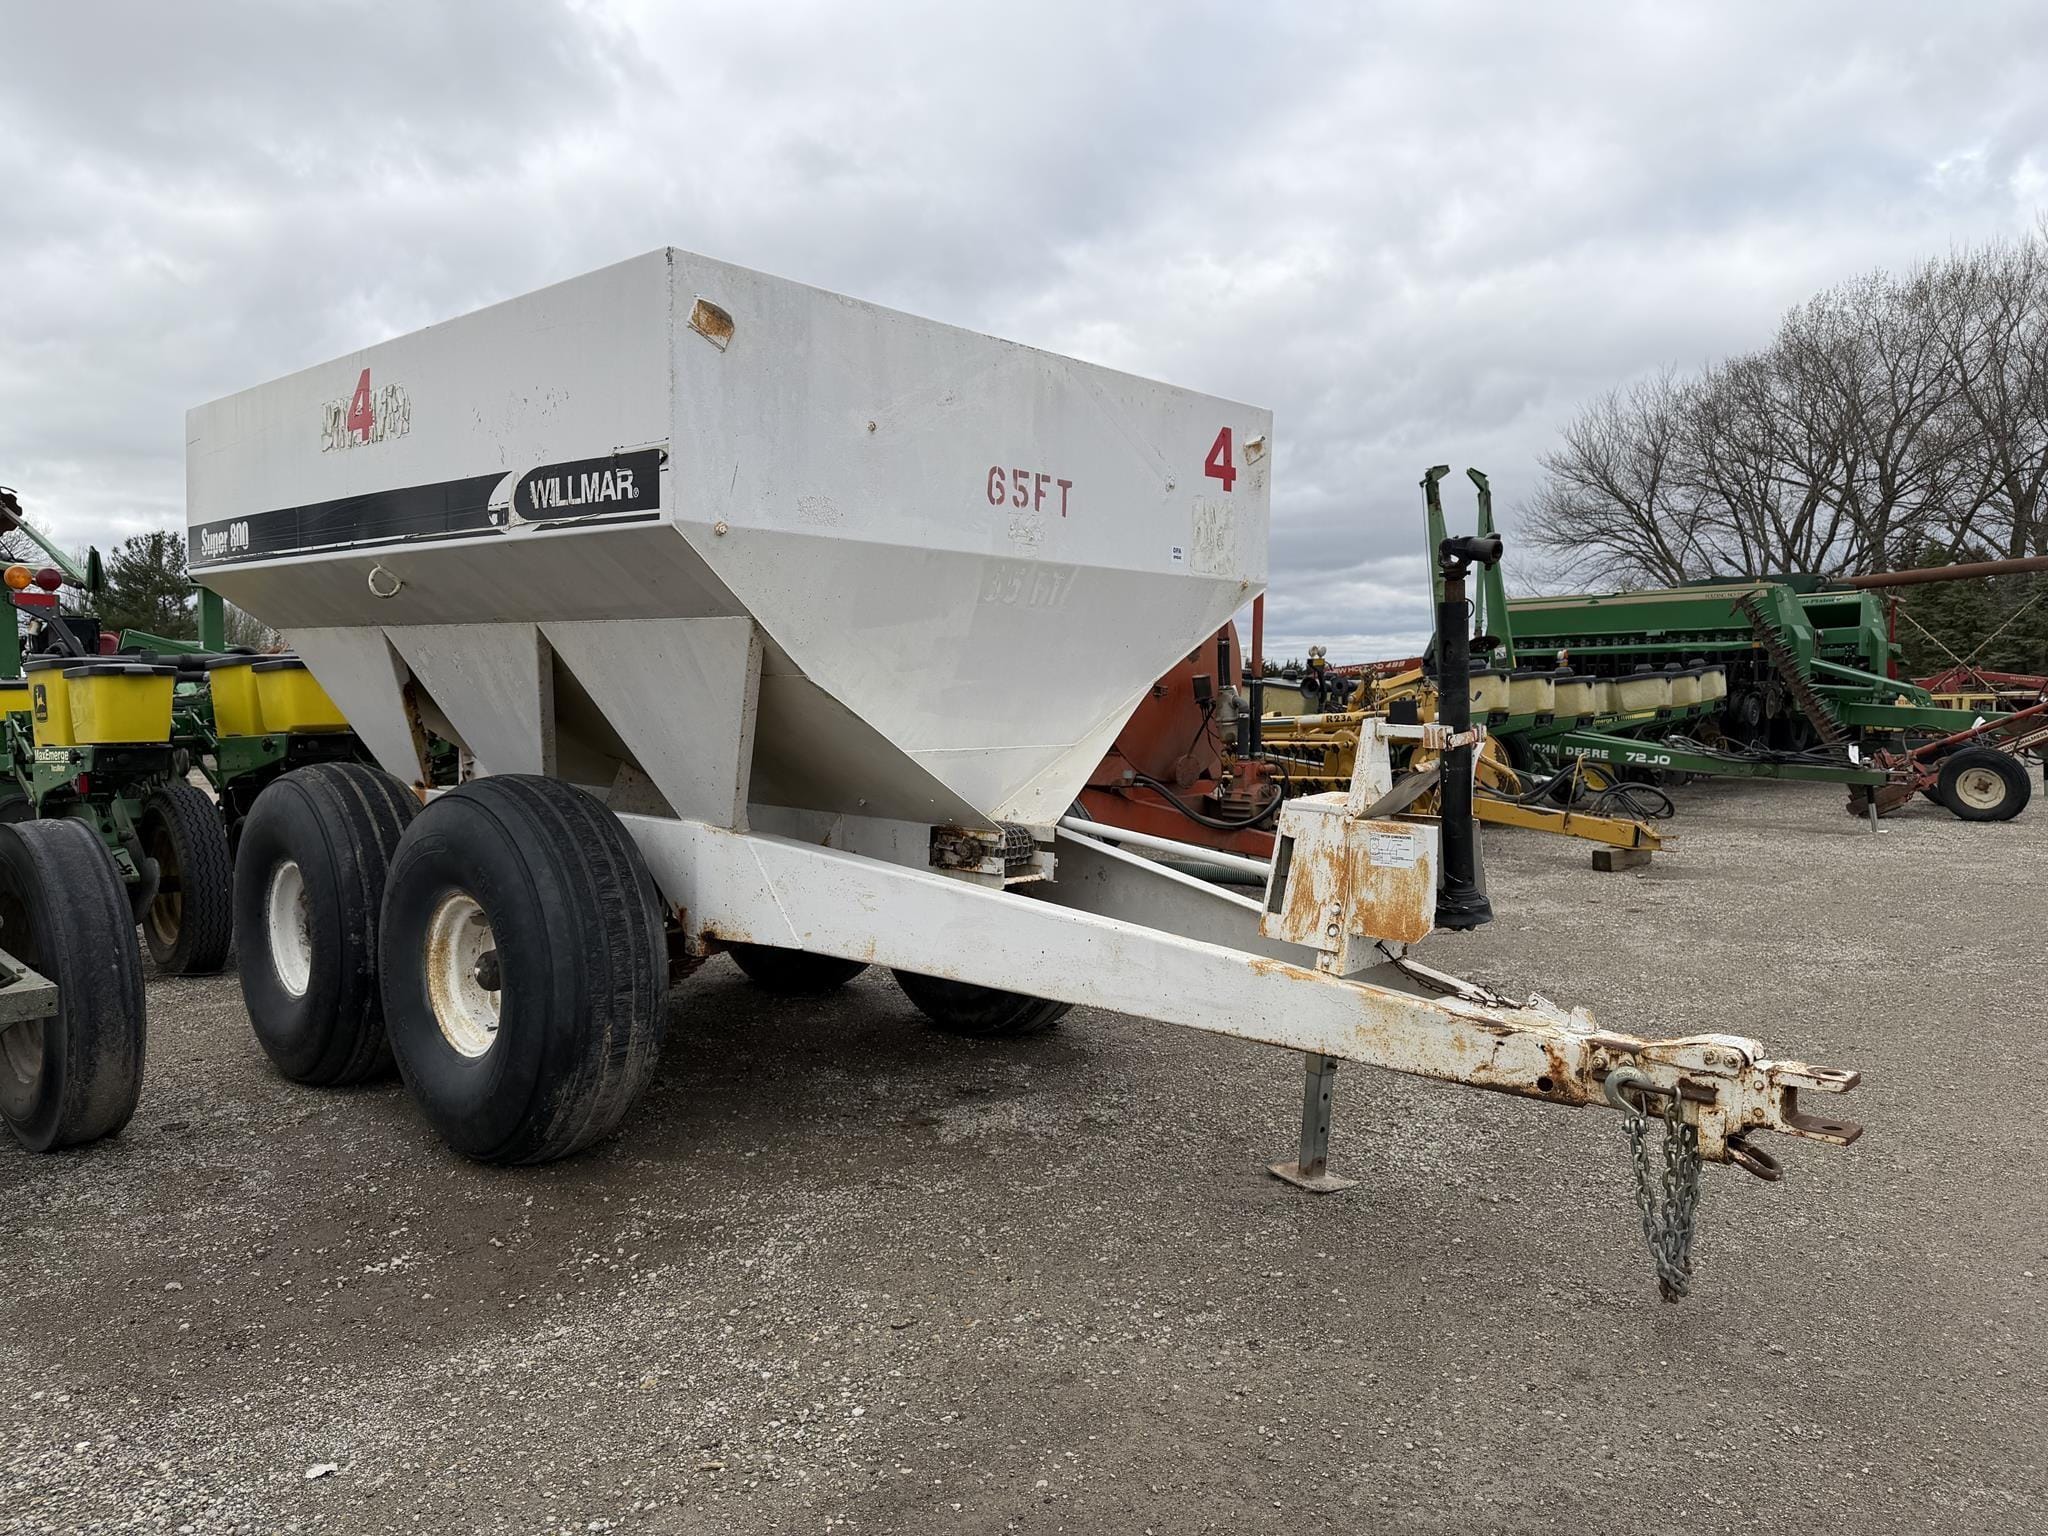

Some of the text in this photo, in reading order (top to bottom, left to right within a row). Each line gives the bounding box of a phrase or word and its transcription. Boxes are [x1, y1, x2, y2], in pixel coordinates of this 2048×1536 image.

[347, 367, 374, 441] 4
[1204, 427, 1237, 492] 4
[529, 468, 634, 509] WILLMAR
[987, 465, 1073, 518] 65FT
[201, 521, 249, 558] Super 800
[34, 748, 69, 763] MaxEmerge
[1530, 743, 1609, 759] OHN DEERE
